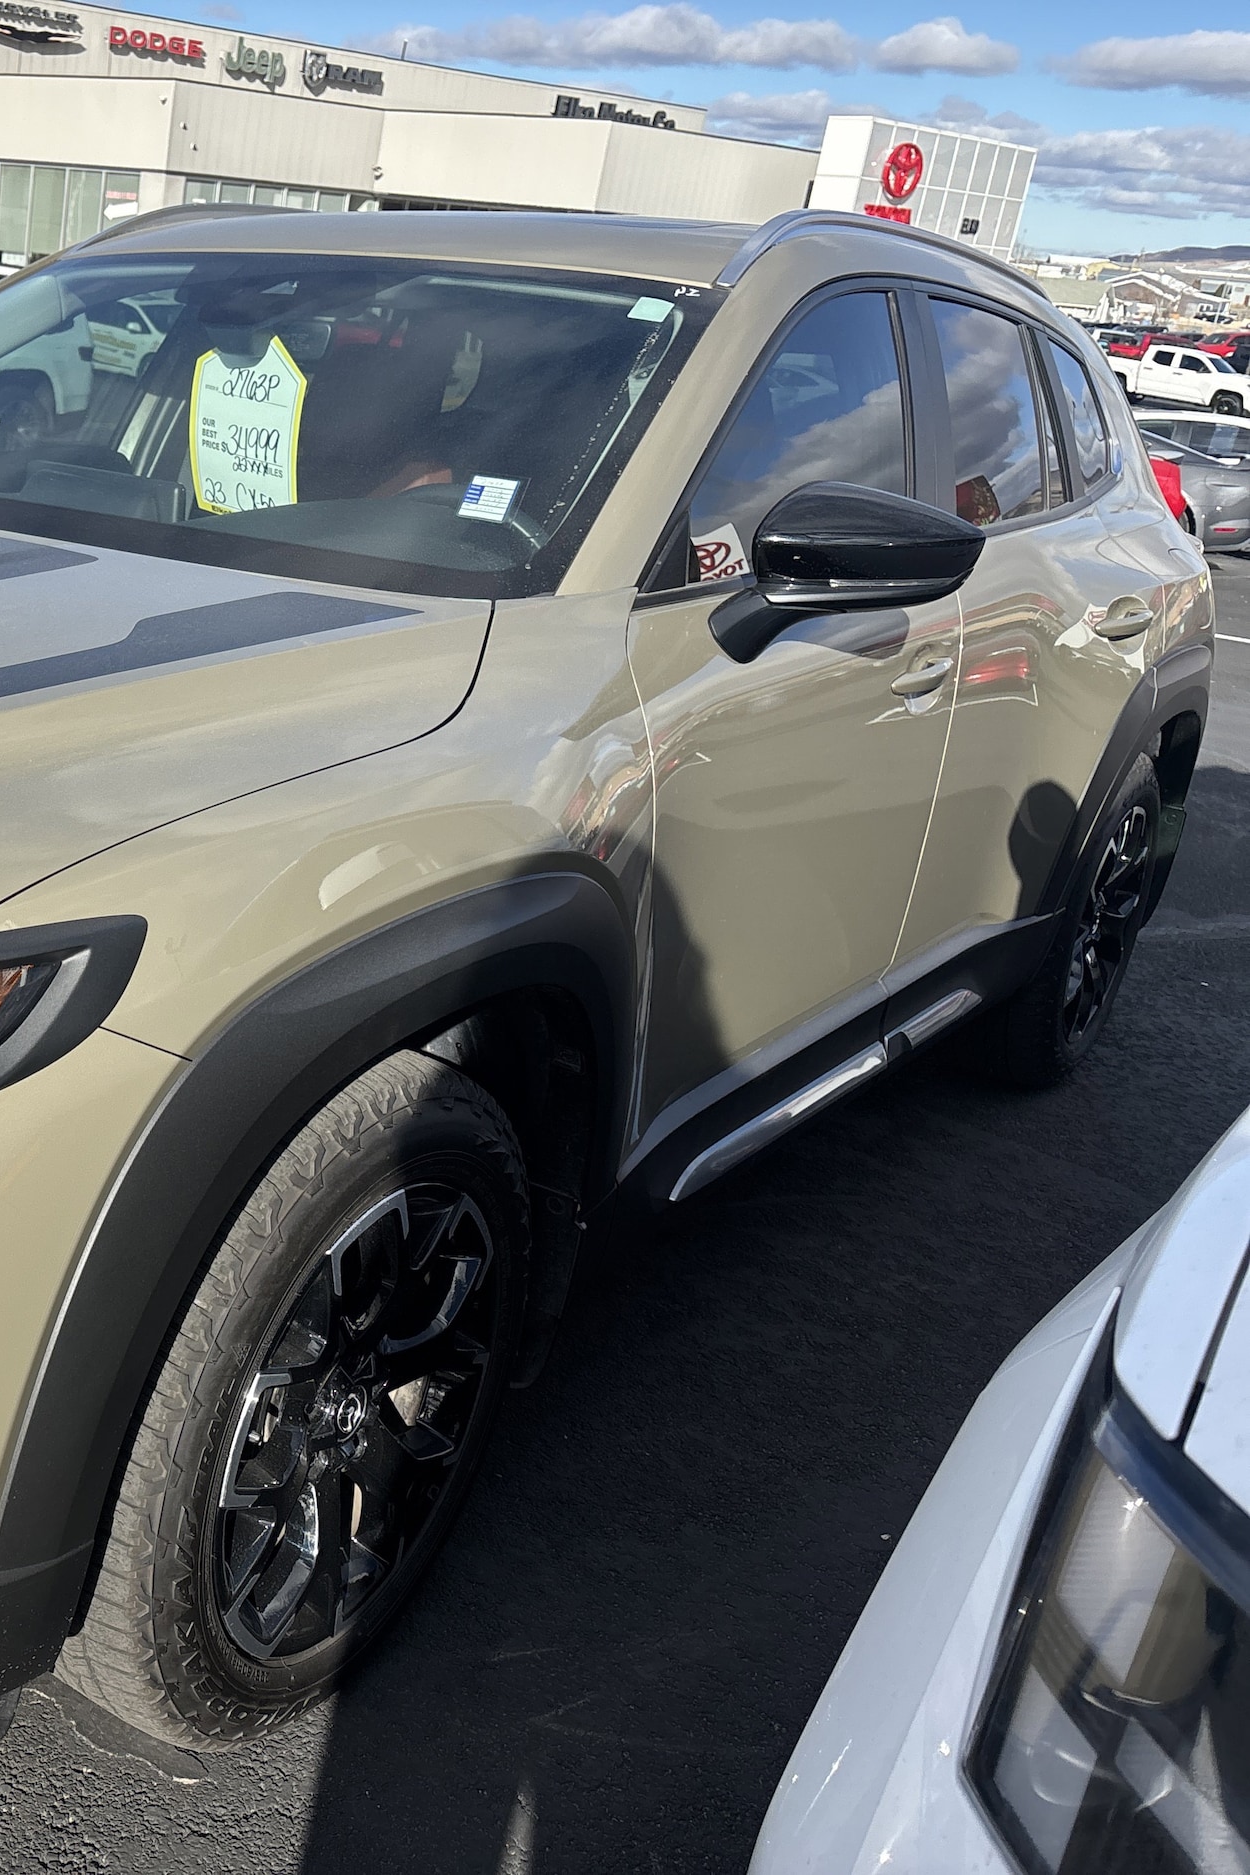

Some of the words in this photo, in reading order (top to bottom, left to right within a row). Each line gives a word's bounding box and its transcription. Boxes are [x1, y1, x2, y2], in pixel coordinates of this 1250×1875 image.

[109, 25, 204, 58] DODGE
[225, 36, 285, 83] Jeep
[326, 63, 383, 86] RAM
[554, 94, 596, 118] Elko
[201, 428, 217, 440] BEST
[202, 417, 216, 428] OUR
[201, 439, 220, 451] PRICE
[204, 477, 227, 504] 23
